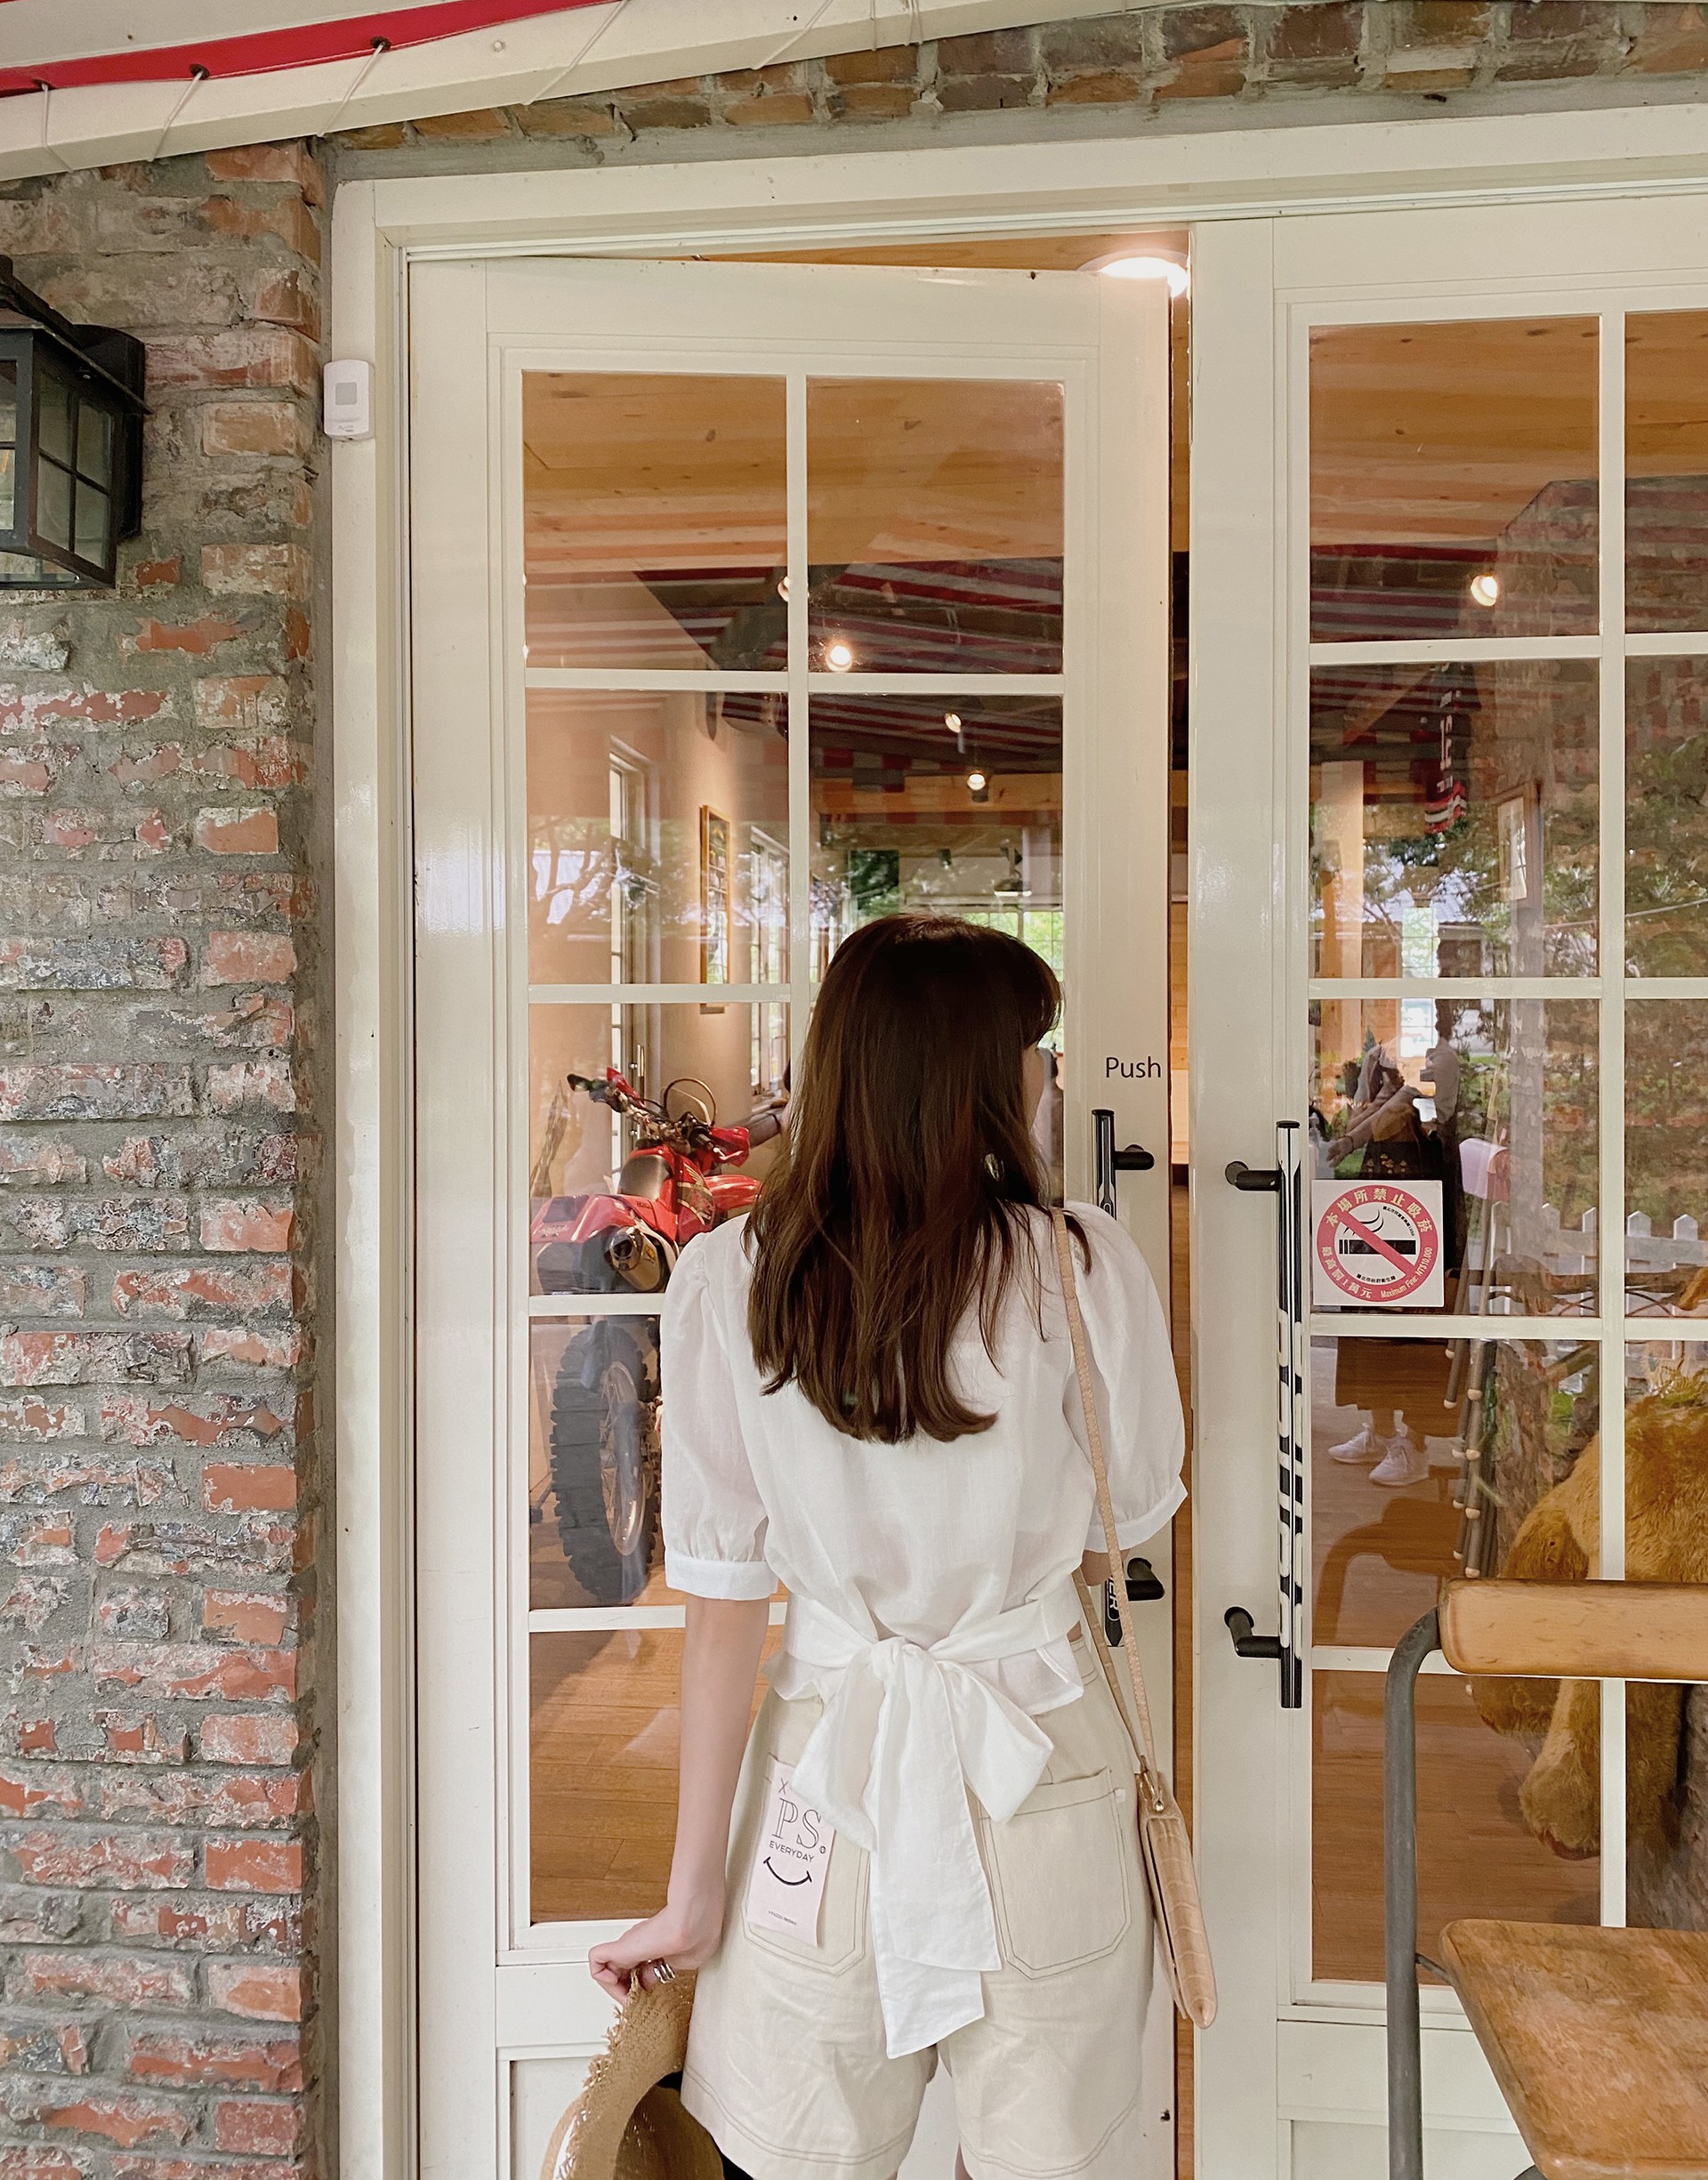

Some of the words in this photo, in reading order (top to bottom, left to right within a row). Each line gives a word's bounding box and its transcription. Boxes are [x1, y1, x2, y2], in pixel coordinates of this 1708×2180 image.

[1106, 1055, 1161, 1078] Push
[1325, 1188, 1433, 1233] 本場所禁止吸菸
[1381, 1285, 1407, 1298] Maximum
[769, 1840, 815, 1862] EVERYDAY
